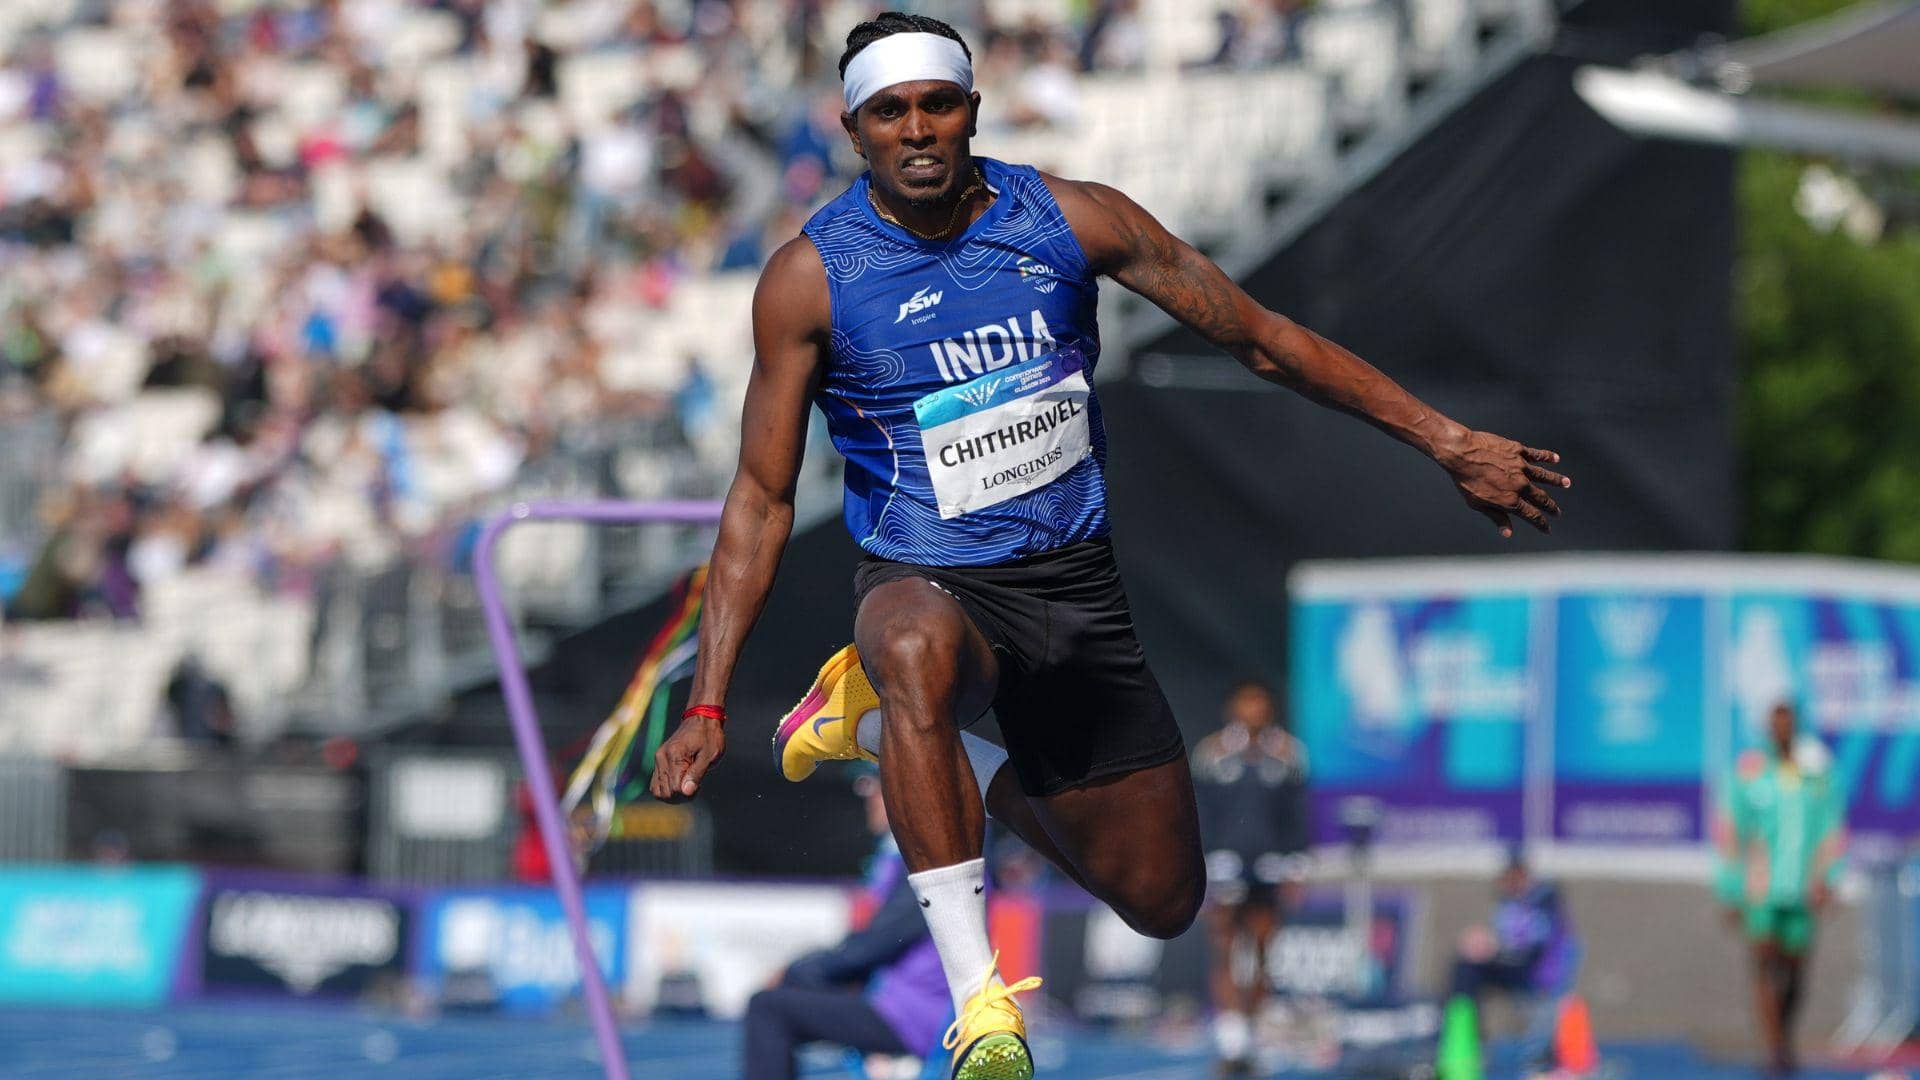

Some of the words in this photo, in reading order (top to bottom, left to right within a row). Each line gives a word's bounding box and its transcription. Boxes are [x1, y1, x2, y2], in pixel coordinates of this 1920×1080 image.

[893, 289, 944, 325] JSW
[929, 309, 1058, 384] INDIA
[939, 397, 1081, 468] CHITHRAVEL
[981, 446, 1063, 490] LONGINES
